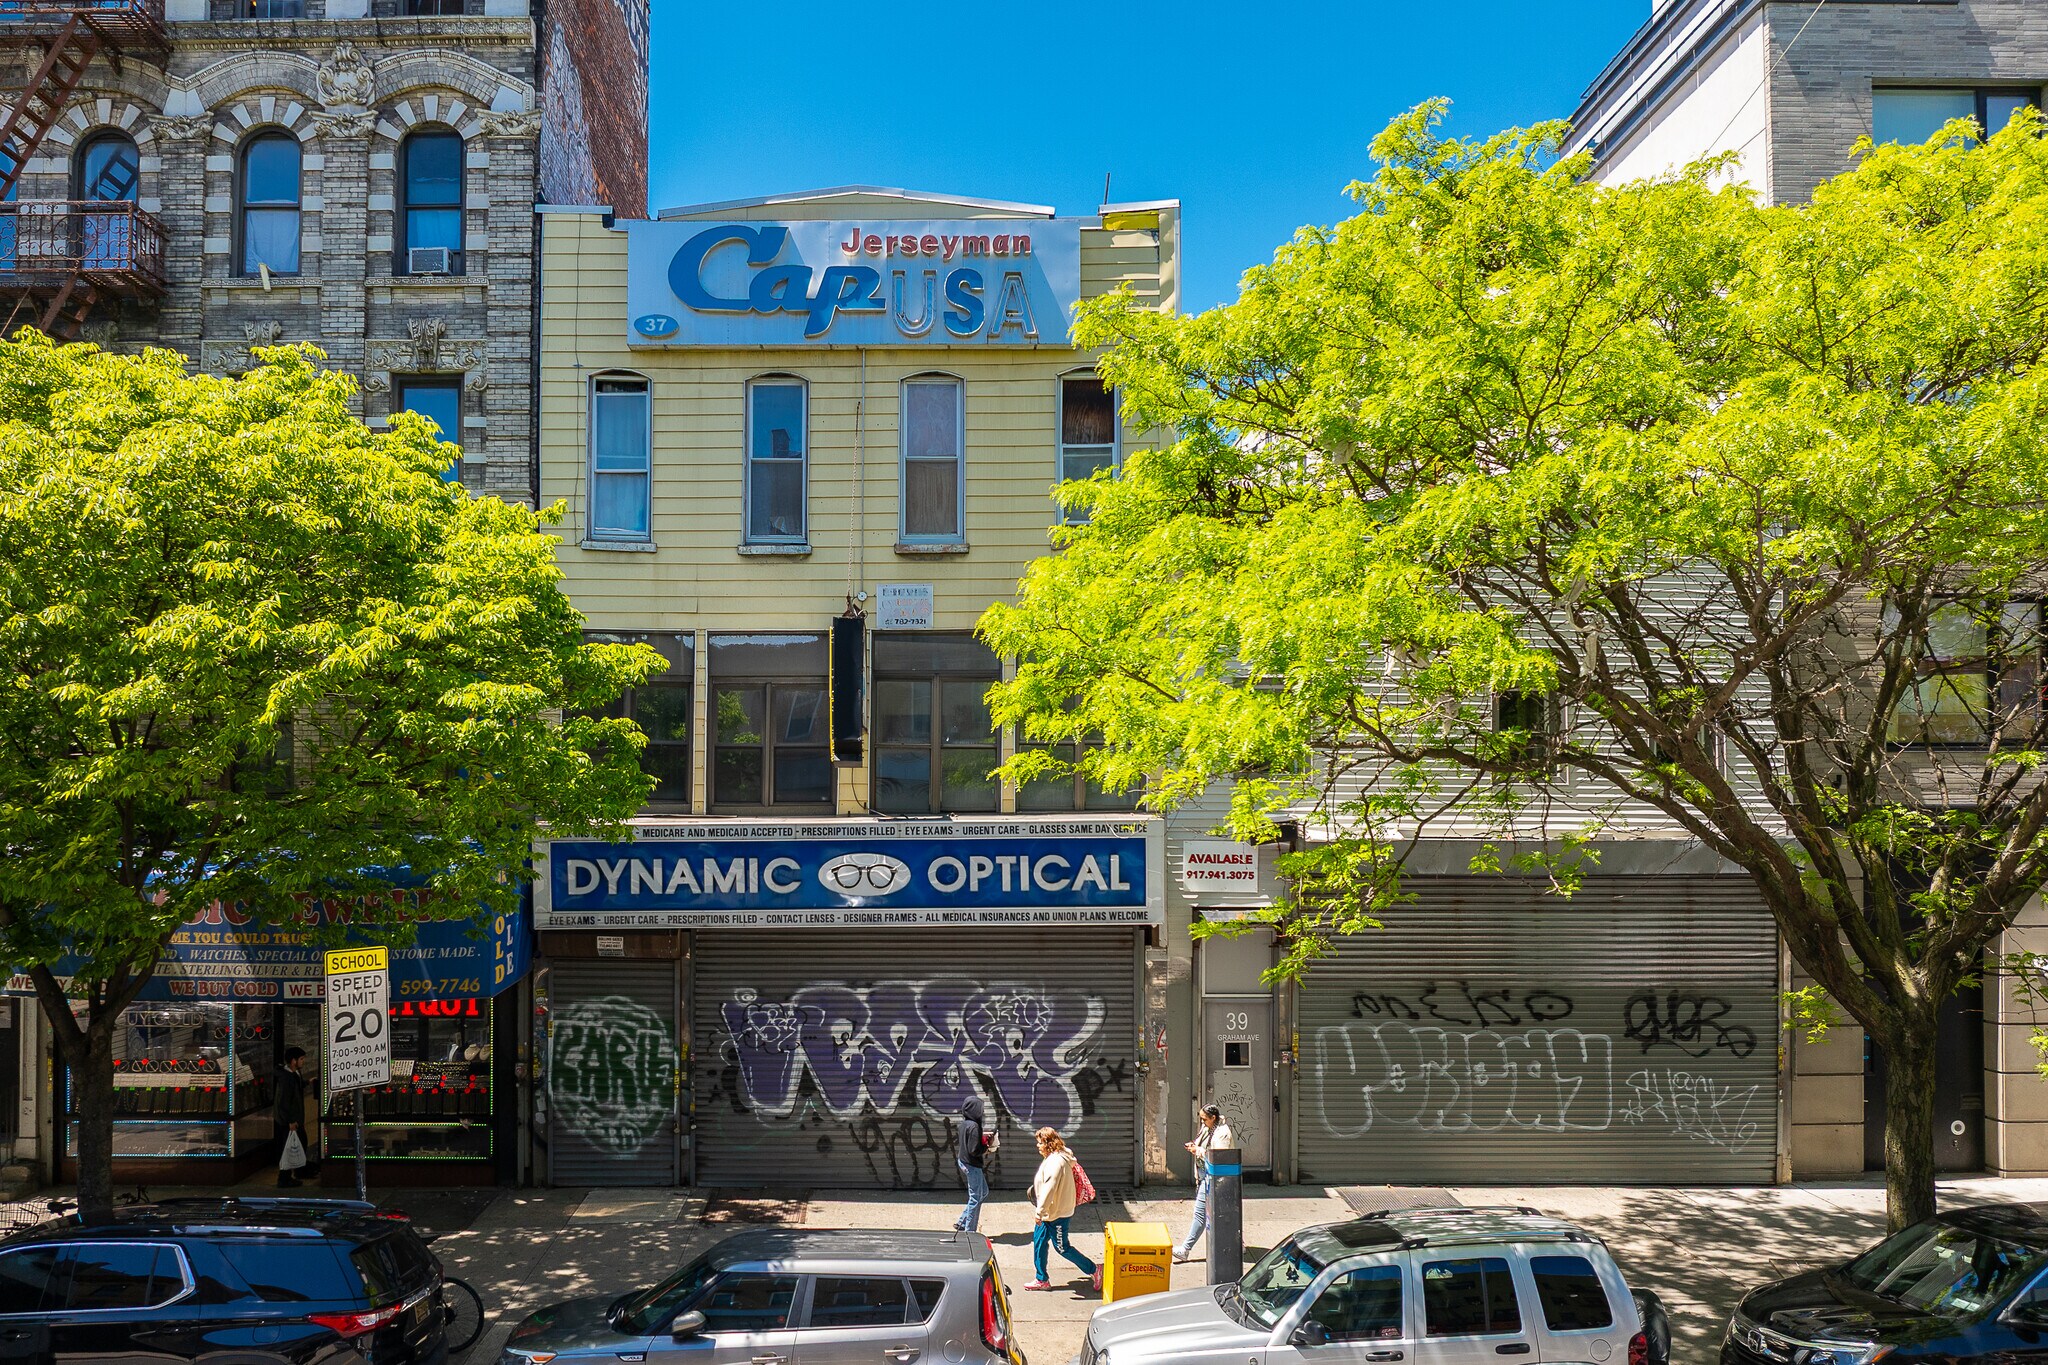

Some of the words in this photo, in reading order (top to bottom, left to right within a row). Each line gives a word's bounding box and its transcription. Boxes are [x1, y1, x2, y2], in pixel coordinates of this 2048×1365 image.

[841, 228, 1032, 261] Jerseyman
[668, 224, 887, 339] Cap
[892, 266, 1039, 338] USA
[645, 318, 668, 332] 37
[643, 828, 685, 838] MEDICARE
[687, 828, 706, 838] AND
[708, 827, 749, 837] MEDICAID
[751, 827, 793, 837] ACCEPTED
[801, 826, 867, 836] PRESCRIPTIONS
[869, 826, 896, 836] FILLED
[905, 826, 921, 836] EYE
[923, 826, 953, 836] EXAMS
[962, 825, 996, 836] URGENT
[998, 825, 1020, 835] CARE
[1029, 825, 1067, 834] GLASSES
[1069, 824, 1093, 834] SAME
[1095, 824, 1111, 833] DAY
[1188, 854, 1253, 865] AVAILABLE
[567, 856, 802, 896] DYNAMIC
[927, 854, 1131, 893] OPTICAL
[1186, 870, 1255, 880] 917.941.3075
[549, 916, 564, 926] EYE
[566, 916, 596, 925] EXAMS
[604, 915, 635, 925] URGENT
[638, 915, 659, 925] CARE
[667, 914, 730, 925] PRESCRIPTIONS
[732, 914, 758, 924] FILLED
[766, 914, 803, 924] CONTACT
[805, 914, 835, 923] LENSES
[843, 913, 882, 923] DESIGNER
[885, 913, 917, 923] FRAMES
[925, 912, 940, 922] ALL
[942, 912, 977, 922] MEDICAL
[979, 912, 1031, 922] INSURANCES
[1033, 911, 1050, 921] AND
[1052, 911, 1078, 921] UNION
[1080, 911, 1107, 921] PLANS
[1109, 911, 1149, 921] WELCOME
[193, 933, 221, 944] YOU
[224, 933, 270, 944] COULD
[273, 933, 313, 945] TRUS
[189, 949, 249, 962] WATCHES
[256, 949, 308, 962] SPECIAL
[388, 948, 437, 961] USTOME
[438, 946, 476, 960] MADE
[331, 953, 382, 971] SCHOOL
[180, 964, 243, 976] STERLING
[244, 964, 288, 976] SILVER
[291, 965, 301, 976] &
[11, 977, 34, 990] WE
[169, 981, 195, 996] WE
[197, 981, 231, 996] BUY
[233, 981, 279, 997] GOLD
[289, 984, 312, 996] WE
[332, 974, 383, 992] SPEED
[400, 977, 481, 996] 599-7746
[338, 991, 377, 1008] LIMIT
[334, 1008, 383, 1043] 20
[1226, 1012, 1248, 1031] 39
[332, 1045, 372, 1058] 7:00-9:00
[374, 1043, 387, 1053] AM
[332, 1057, 374, 1072] 2:00-4:00
[375, 1056, 387, 1066] PM
[339, 1072, 358, 1084] MON
[367, 1070, 381, 1080] FRI
